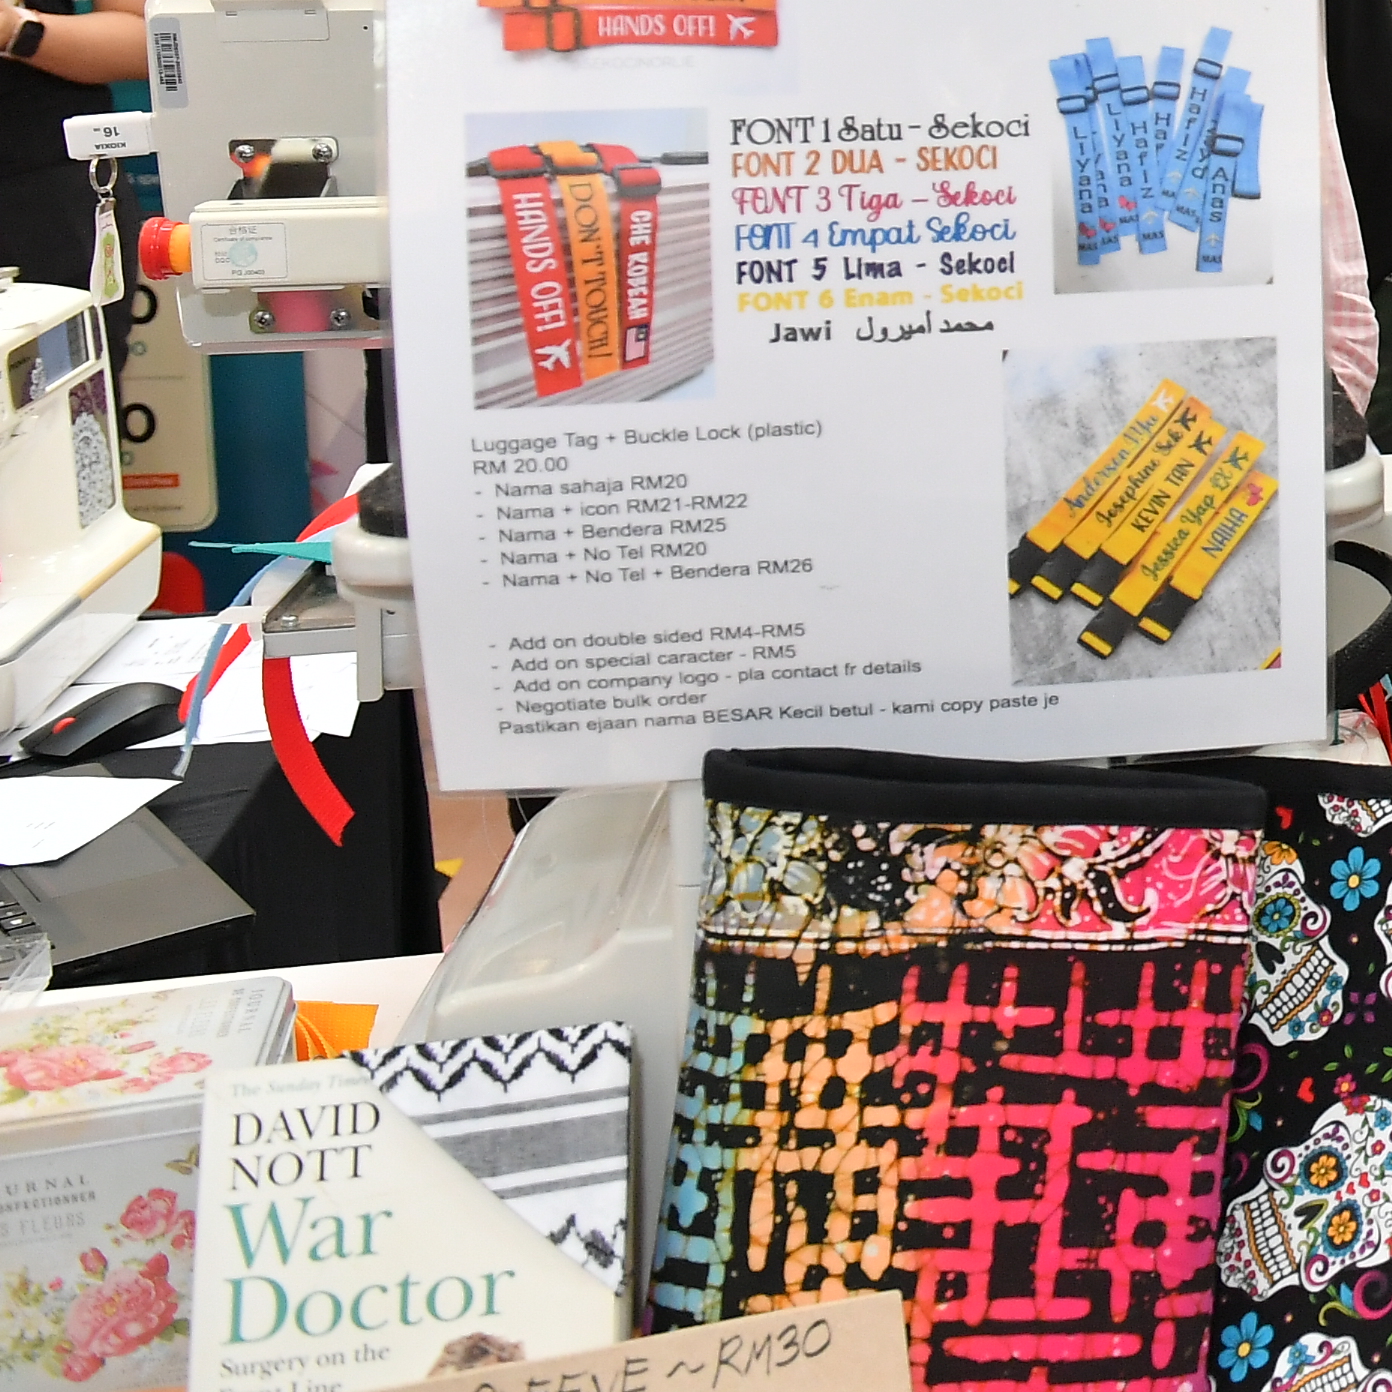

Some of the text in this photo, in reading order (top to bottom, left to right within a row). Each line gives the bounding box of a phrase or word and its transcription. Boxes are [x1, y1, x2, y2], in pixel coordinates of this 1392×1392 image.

[598, 15, 717, 38] HANDS OFF!
[730, 111, 1031, 146] FONT 1 Satu Sekoci
[731, 144, 999, 178] FONT 2 DUA SEKOCI
[731, 179, 1018, 223] FONT 3 Tiga Sekoci
[629, 209, 653, 247] CHE
[735, 211, 1017, 254] FONT 4 Empat Sekoci
[512, 192, 567, 333] HANDS OFF!
[584, 268, 613, 360] TOUCH!
[737, 280, 1025, 313] FONT 6 Enam Sekoci
[769, 320, 832, 343] Jawi
[938, 317, 995, 334] محمد
[471, 420, 823, 456] Luggage Tag Buckle Lock (plastic)
[496, 494, 748, 522] Nama icon RM21-RM22
[1130, 457, 1195, 534] KEVIN TAN
[508, 622, 807, 651] Add on double sided RM4-RM5
[513, 678, 552, 695] Add
[558, 679, 582, 692] on
[587, 672, 674, 697] company
[679, 669, 720, 690] logo
[770, 663, 839, 681] contact
[862, 657, 923, 677] details
[499, 690, 1061, 737] Pastikan ejaan nama BESAR Kecil betul kami copy paste je
[516, 689, 708, 717] Negotiate bulk order
[231, 1100, 381, 1147] DAVID
[231, 1143, 373, 1192] NOTT
[223, 1195, 394, 1271] War
[219, 1269, 516, 1346] Doctor
[220, 1343, 390, 1381] Surgery on the
